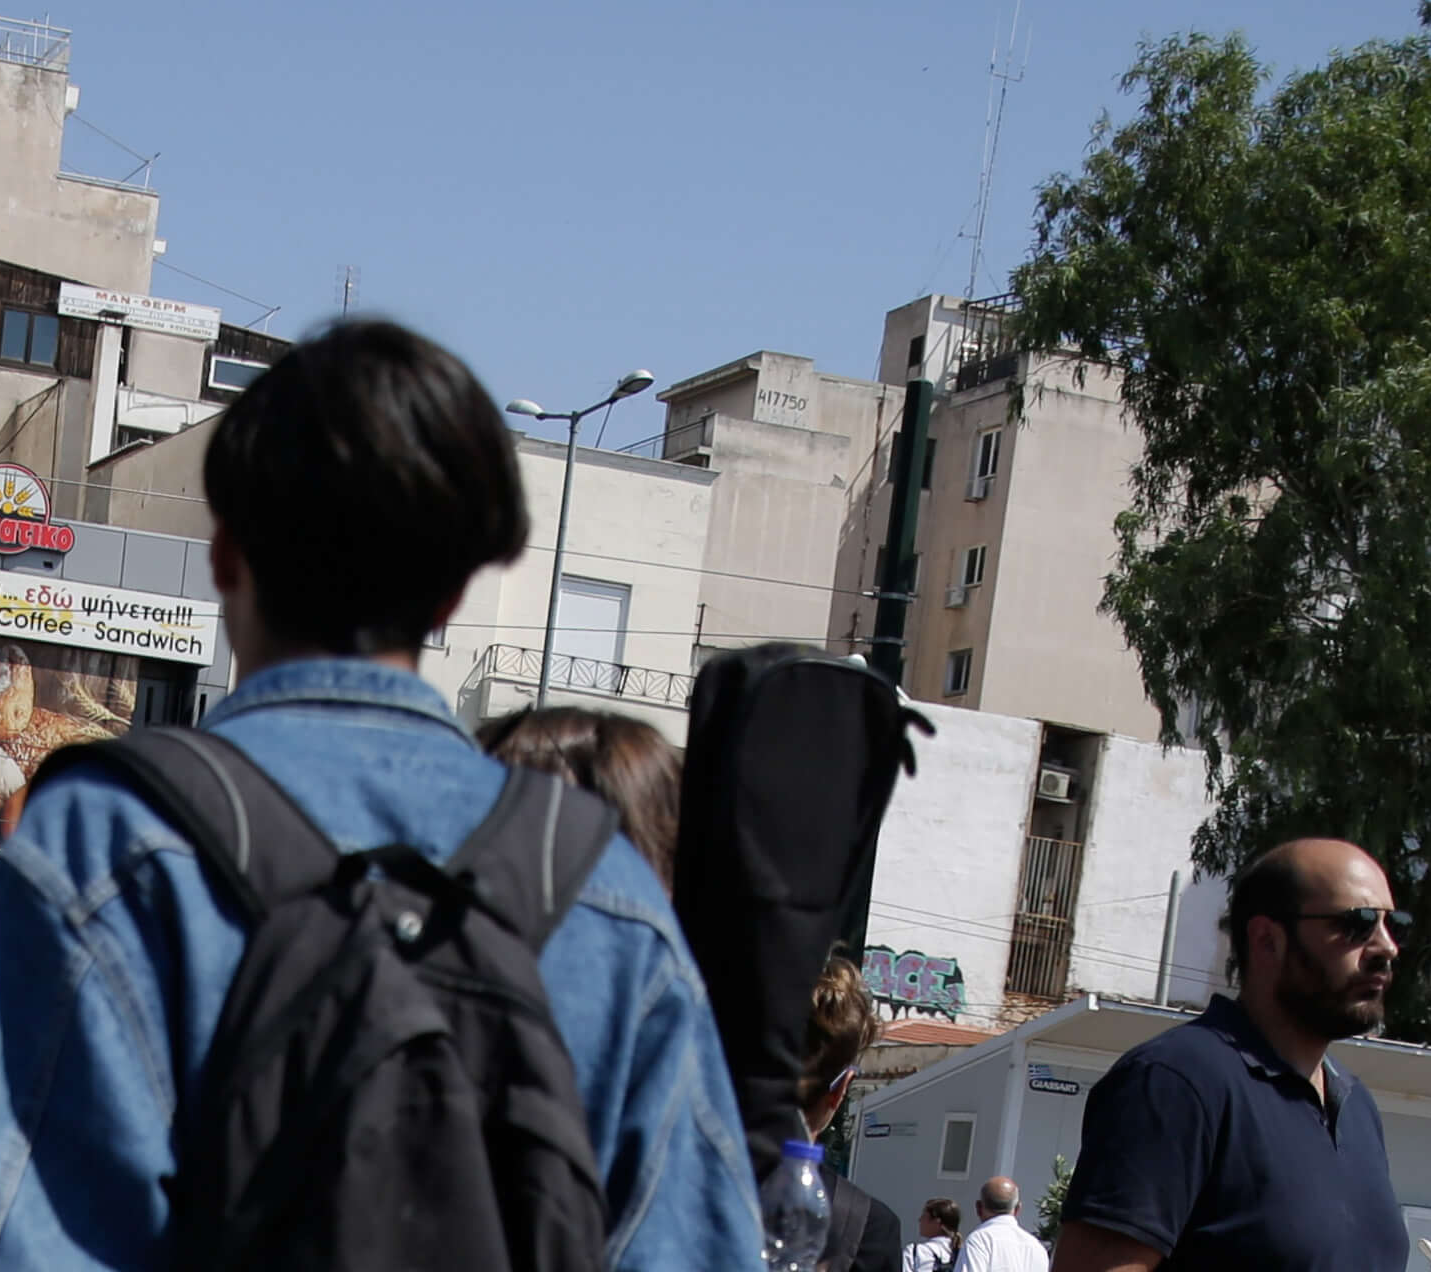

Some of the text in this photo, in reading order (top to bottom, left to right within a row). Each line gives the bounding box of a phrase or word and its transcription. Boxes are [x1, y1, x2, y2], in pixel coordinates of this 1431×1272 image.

[758, 389, 807, 411] 417750
[24, 585, 73, 609] εδώ
[94, 621, 202, 655] Sandwich
